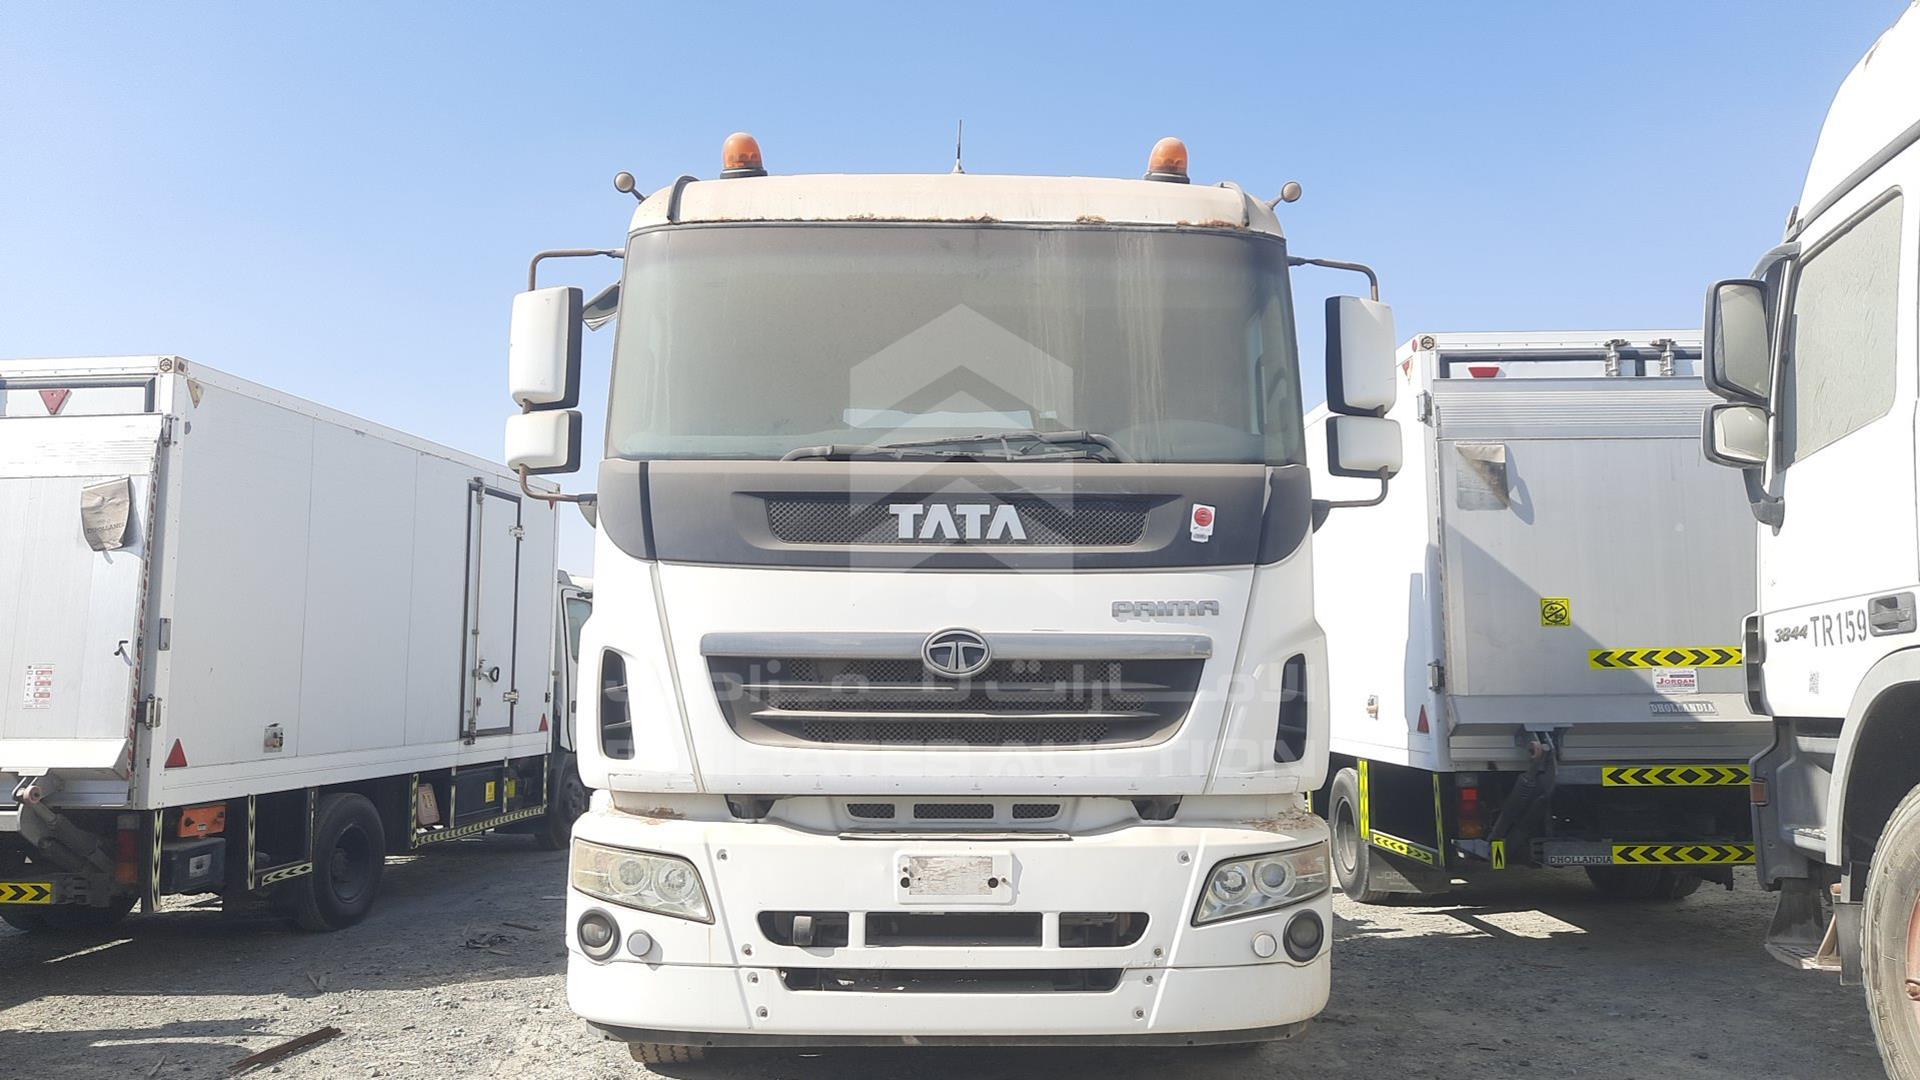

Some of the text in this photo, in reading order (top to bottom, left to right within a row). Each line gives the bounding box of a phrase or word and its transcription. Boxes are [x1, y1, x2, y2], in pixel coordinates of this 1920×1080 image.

[889, 504, 1027, 539] TATA
[1112, 600, 1220, 617] PRIMA
[1774, 624, 1808, 643] 3844
[1810, 609, 1867, 647] TR159
[1650, 702, 1716, 713] DHOLLANDIA
[1550, 856, 1612, 864] DHOLLANDIA
